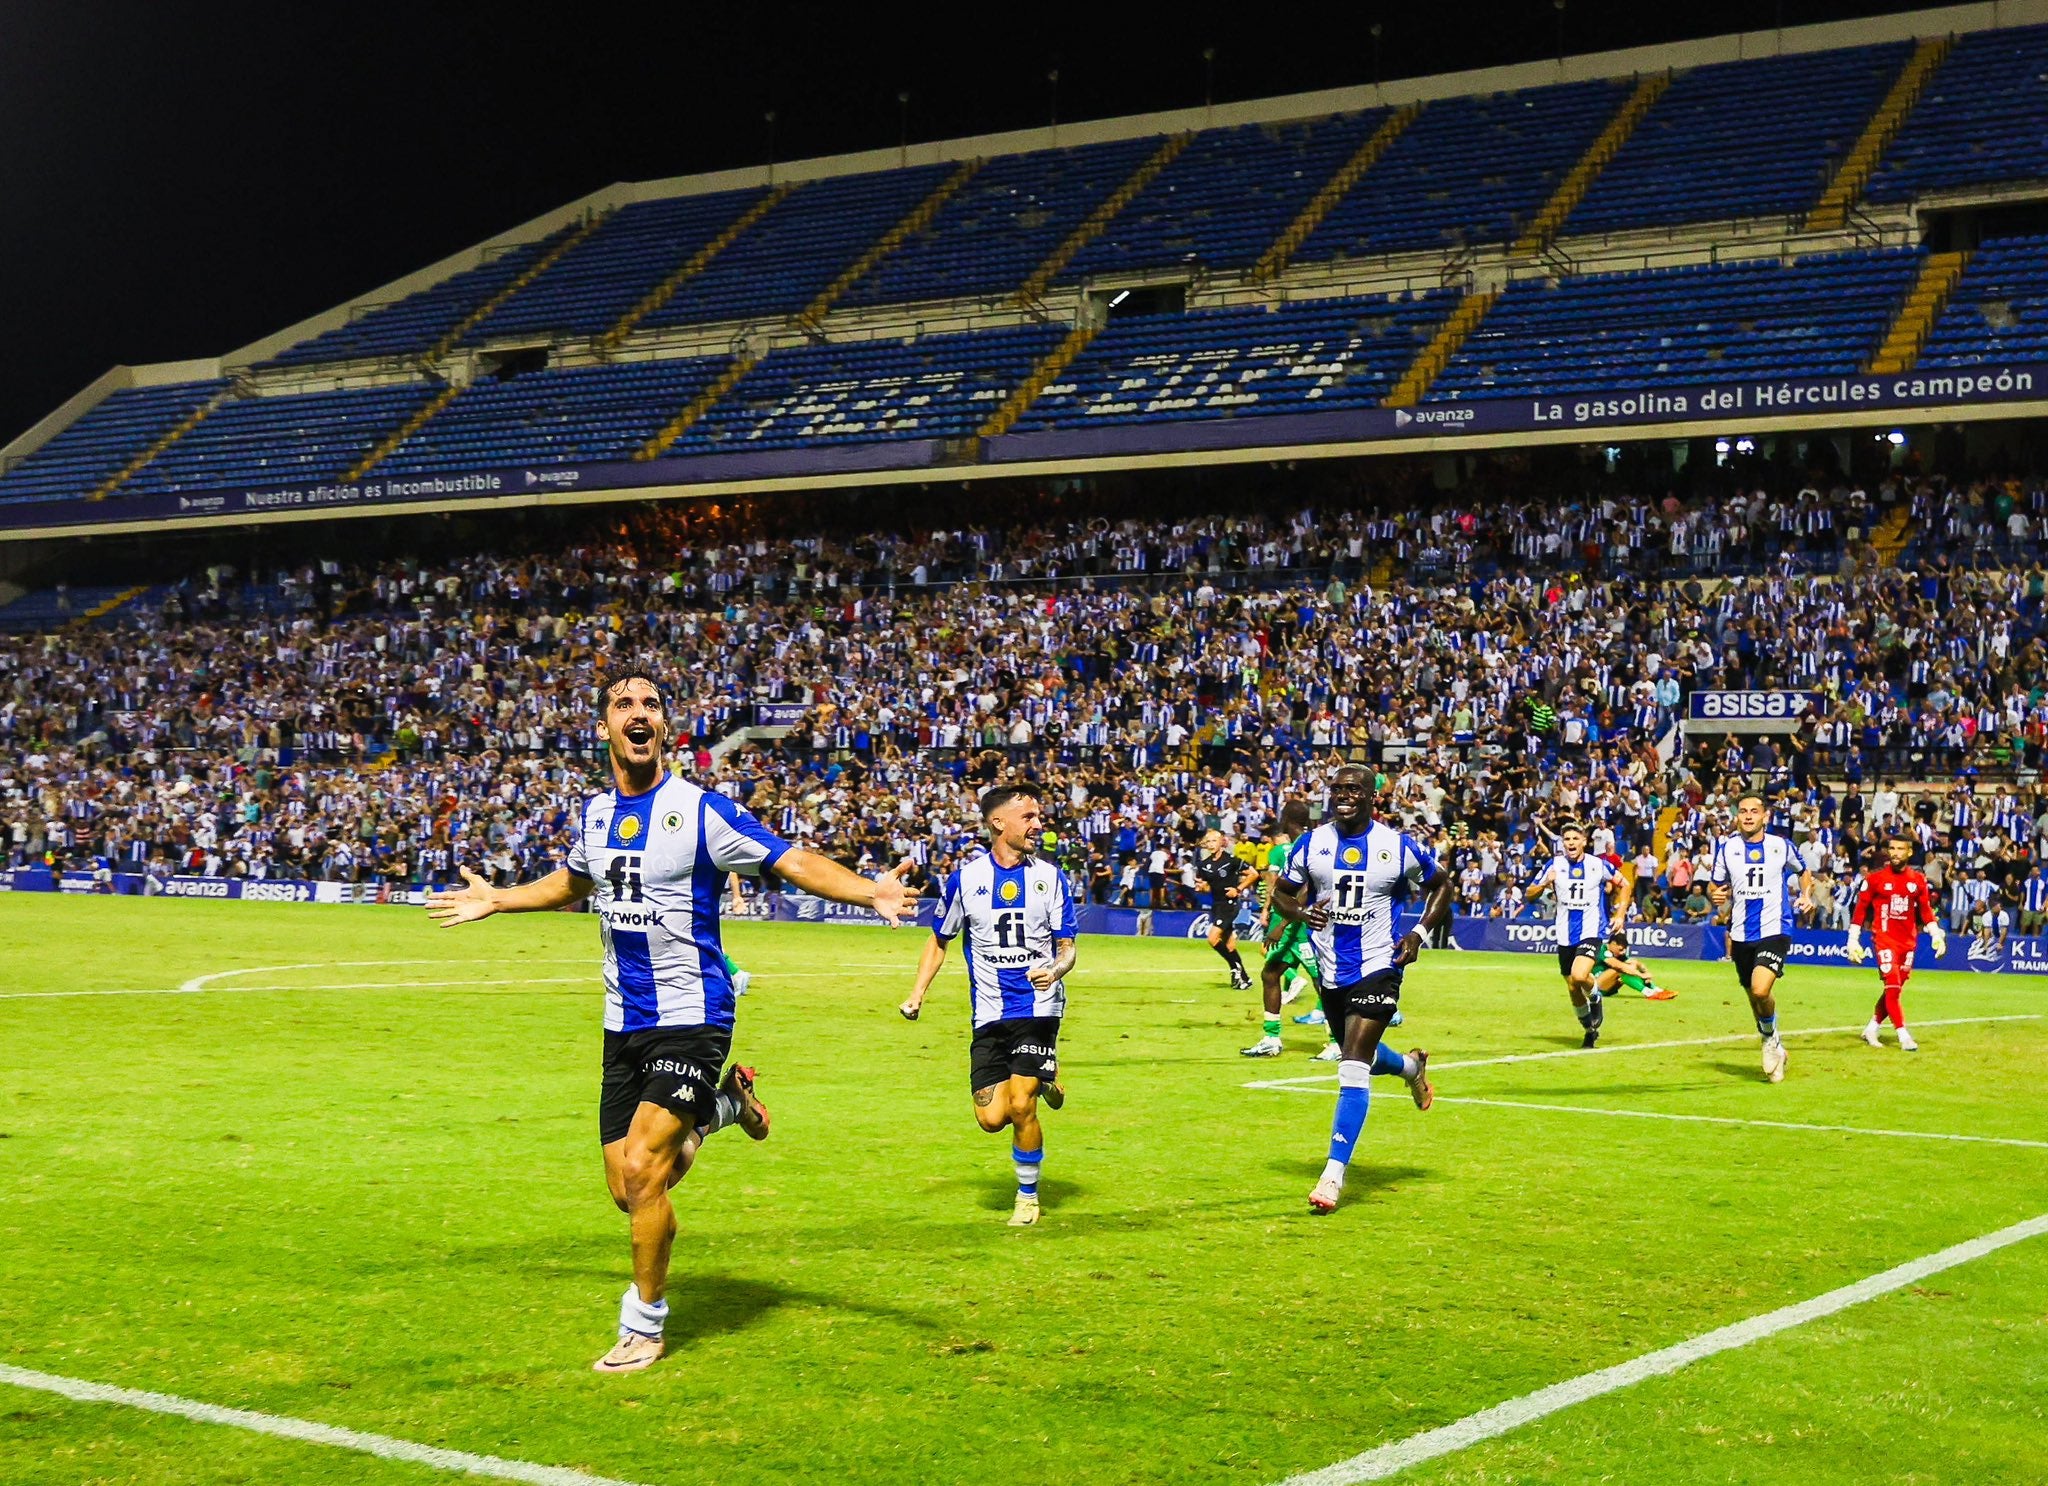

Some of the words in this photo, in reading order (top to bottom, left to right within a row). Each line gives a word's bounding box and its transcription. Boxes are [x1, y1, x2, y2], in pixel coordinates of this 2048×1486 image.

[1532, 401, 1563, 421] La
[1573, 393, 1688, 422] gasolina
[1700, 387, 1742, 410] del
[1755, 380, 1881, 406] Hércules
[1892, 369, 2033, 398] campeón
[1415, 409, 1474, 423] avanza
[245, 490, 302, 506] Nuestra
[307, 485, 360, 502] afición
[364, 485, 382, 498] es
[386, 474, 501, 496] incombustible
[774, 709, 804, 719] avan
[605, 855, 643, 903] fi
[1745, 867, 1764, 887] fi
[165, 880, 229, 897] avanza
[1335, 874, 1364, 908] fi
[1568, 883, 1584, 899] fi
[602, 910, 664, 926] etwork
[1328, 910, 1376, 921] etwork
[994, 912, 1026, 949] fi
